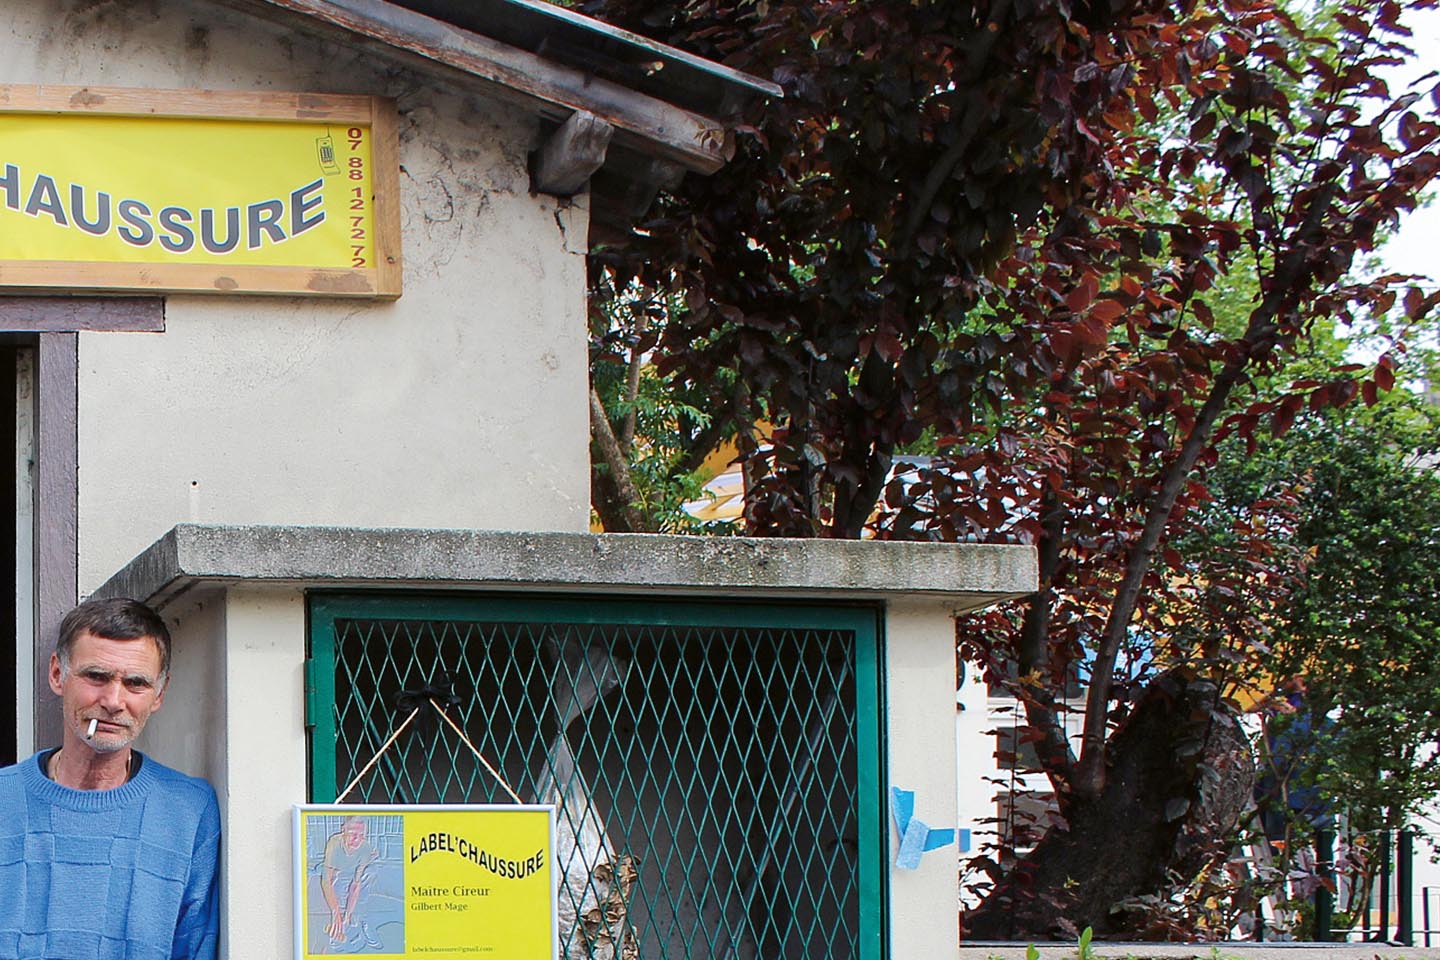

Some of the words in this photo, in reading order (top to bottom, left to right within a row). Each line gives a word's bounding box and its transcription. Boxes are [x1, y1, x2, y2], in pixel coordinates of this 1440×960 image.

[411, 833, 544, 879] LABEL'CHAUSSURE
[453, 886, 490, 897] Cireur
[411, 903, 441, 911] Gilbert
[445, 903, 468, 912] Mage
